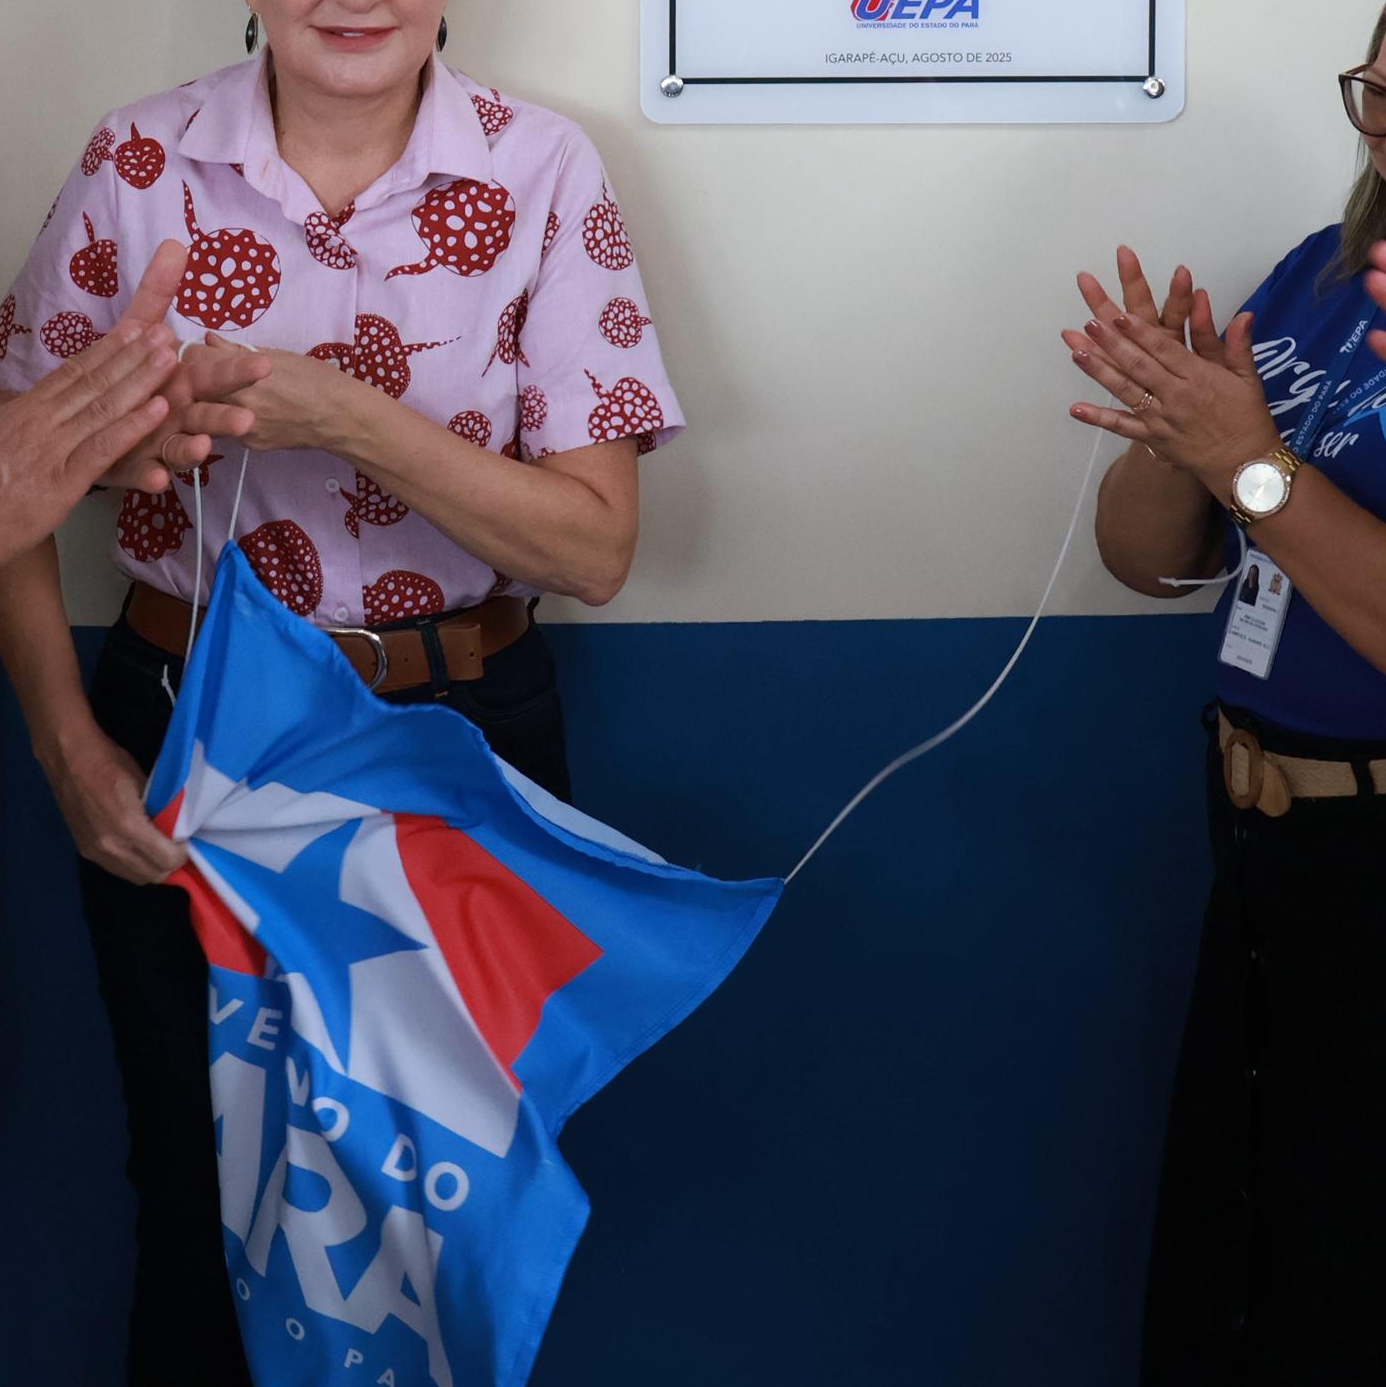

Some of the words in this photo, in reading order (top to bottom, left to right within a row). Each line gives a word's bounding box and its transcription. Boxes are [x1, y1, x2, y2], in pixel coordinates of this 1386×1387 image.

[961, 21, 979, 29] PARÁ
[825, 51, 909, 64] IGARAPÉ-AÇU,
[912, 52, 963, 63] AGOSTO
[966, 52, 982, 63] DE
[985, 52, 1012, 63] 2025
[380, 1133, 470, 1211] DO
